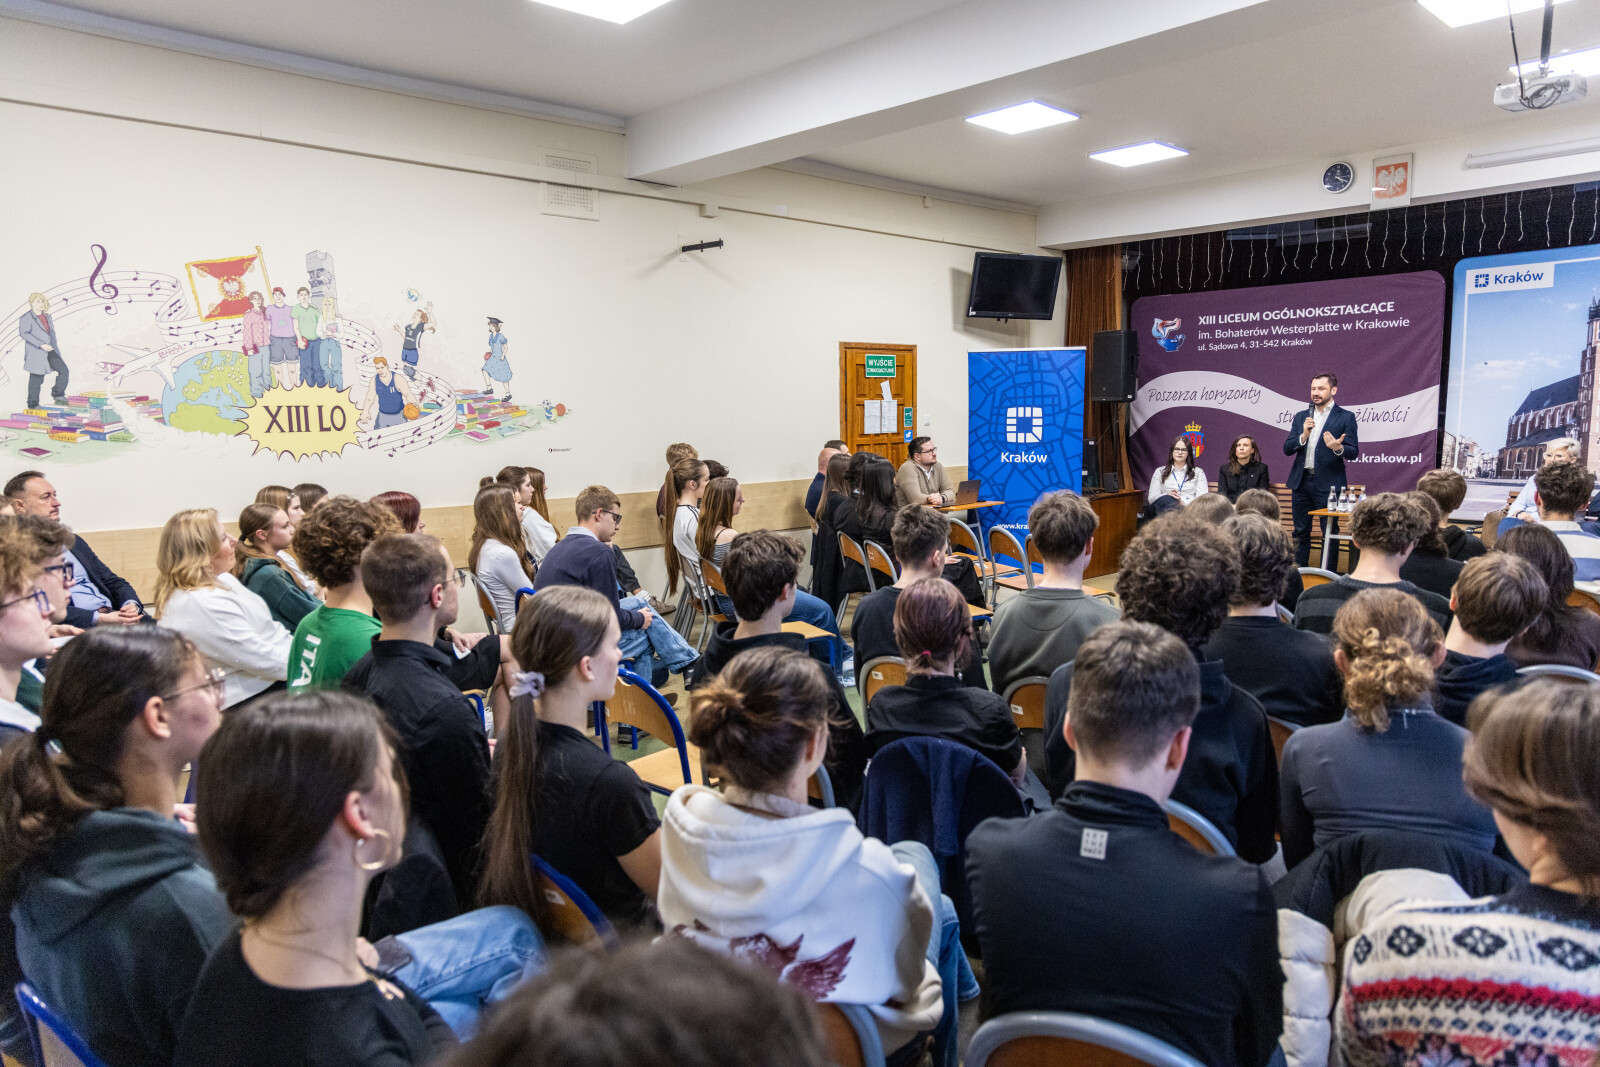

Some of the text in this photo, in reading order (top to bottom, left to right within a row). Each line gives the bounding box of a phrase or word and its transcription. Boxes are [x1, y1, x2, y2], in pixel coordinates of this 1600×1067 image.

[1494, 270, 1544, 285] Kraków
[1198, 302, 1395, 326] XIII LICEUM OGÓLNOKSZTAŁCĄCE
[1198, 316, 1410, 340] im. Bohaterów Westerplatte w Krakowie
[1198, 337, 1313, 352] ul. Sądowa 4, 31-542 Kraków
[868, 358, 894, 367] WYJŚCIE
[1148, 386, 1261, 405] Poszerza horyzonty
[262, 404, 346, 433] XIII LO
[1276, 405, 1410, 424] stw żliwości
[1000, 451, 1048, 463] Kraków
[1347, 452, 1422, 465] .krakow.pl
[996, 522, 1030, 530] www.kra
[292, 633, 322, 687] ITA
